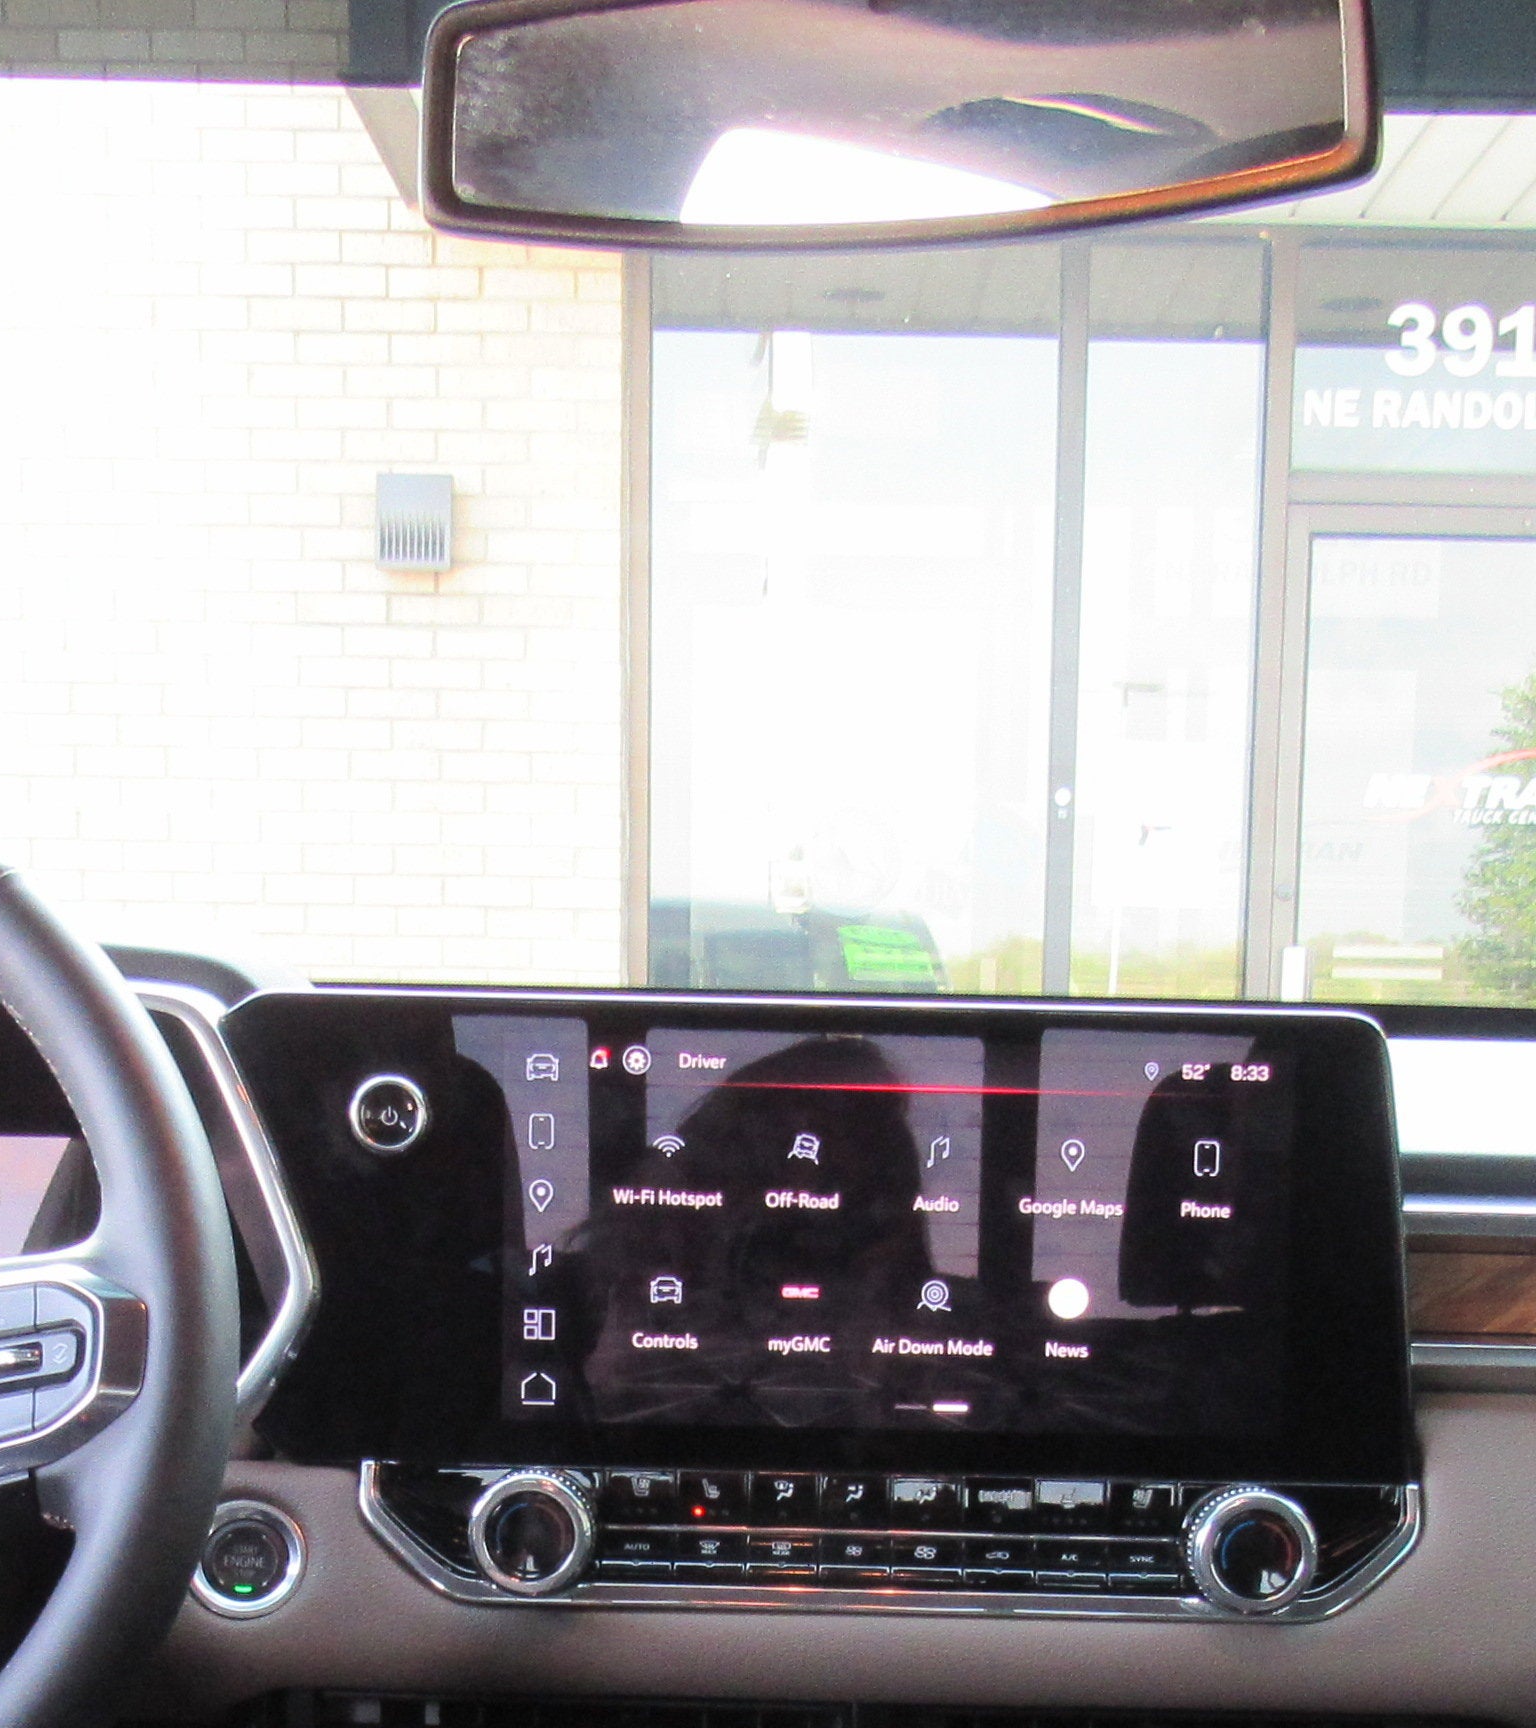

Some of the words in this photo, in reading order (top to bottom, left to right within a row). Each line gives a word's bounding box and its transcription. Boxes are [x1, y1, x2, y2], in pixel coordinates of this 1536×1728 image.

[1303, 389, 1361, 427] NE
[678, 1053, 727, 1070] Driver
[1230, 1065, 1270, 1082] 8:33
[613, 1188, 655, 1205] Wi-Fi
[658, 1189, 723, 1209] Hotspot
[765, 1193, 839, 1209] Off-Road
[912, 1197, 959, 1212] Audio
[1019, 1198, 1076, 1218] Google
[1080, 1201, 1124, 1219] Maps
[1180, 1203, 1231, 1219] Phone
[632, 1332, 698, 1349] Controls
[768, 1336, 831, 1354] myGMC
[872, 1338, 896, 1353] Air
[898, 1338, 944, 1354] Down
[947, 1339, 994, 1356] Mode
[1045, 1343, 1089, 1359] News
[624, 1542, 650, 1551] AUTO
[1129, 1554, 1154, 1563] SYNC
